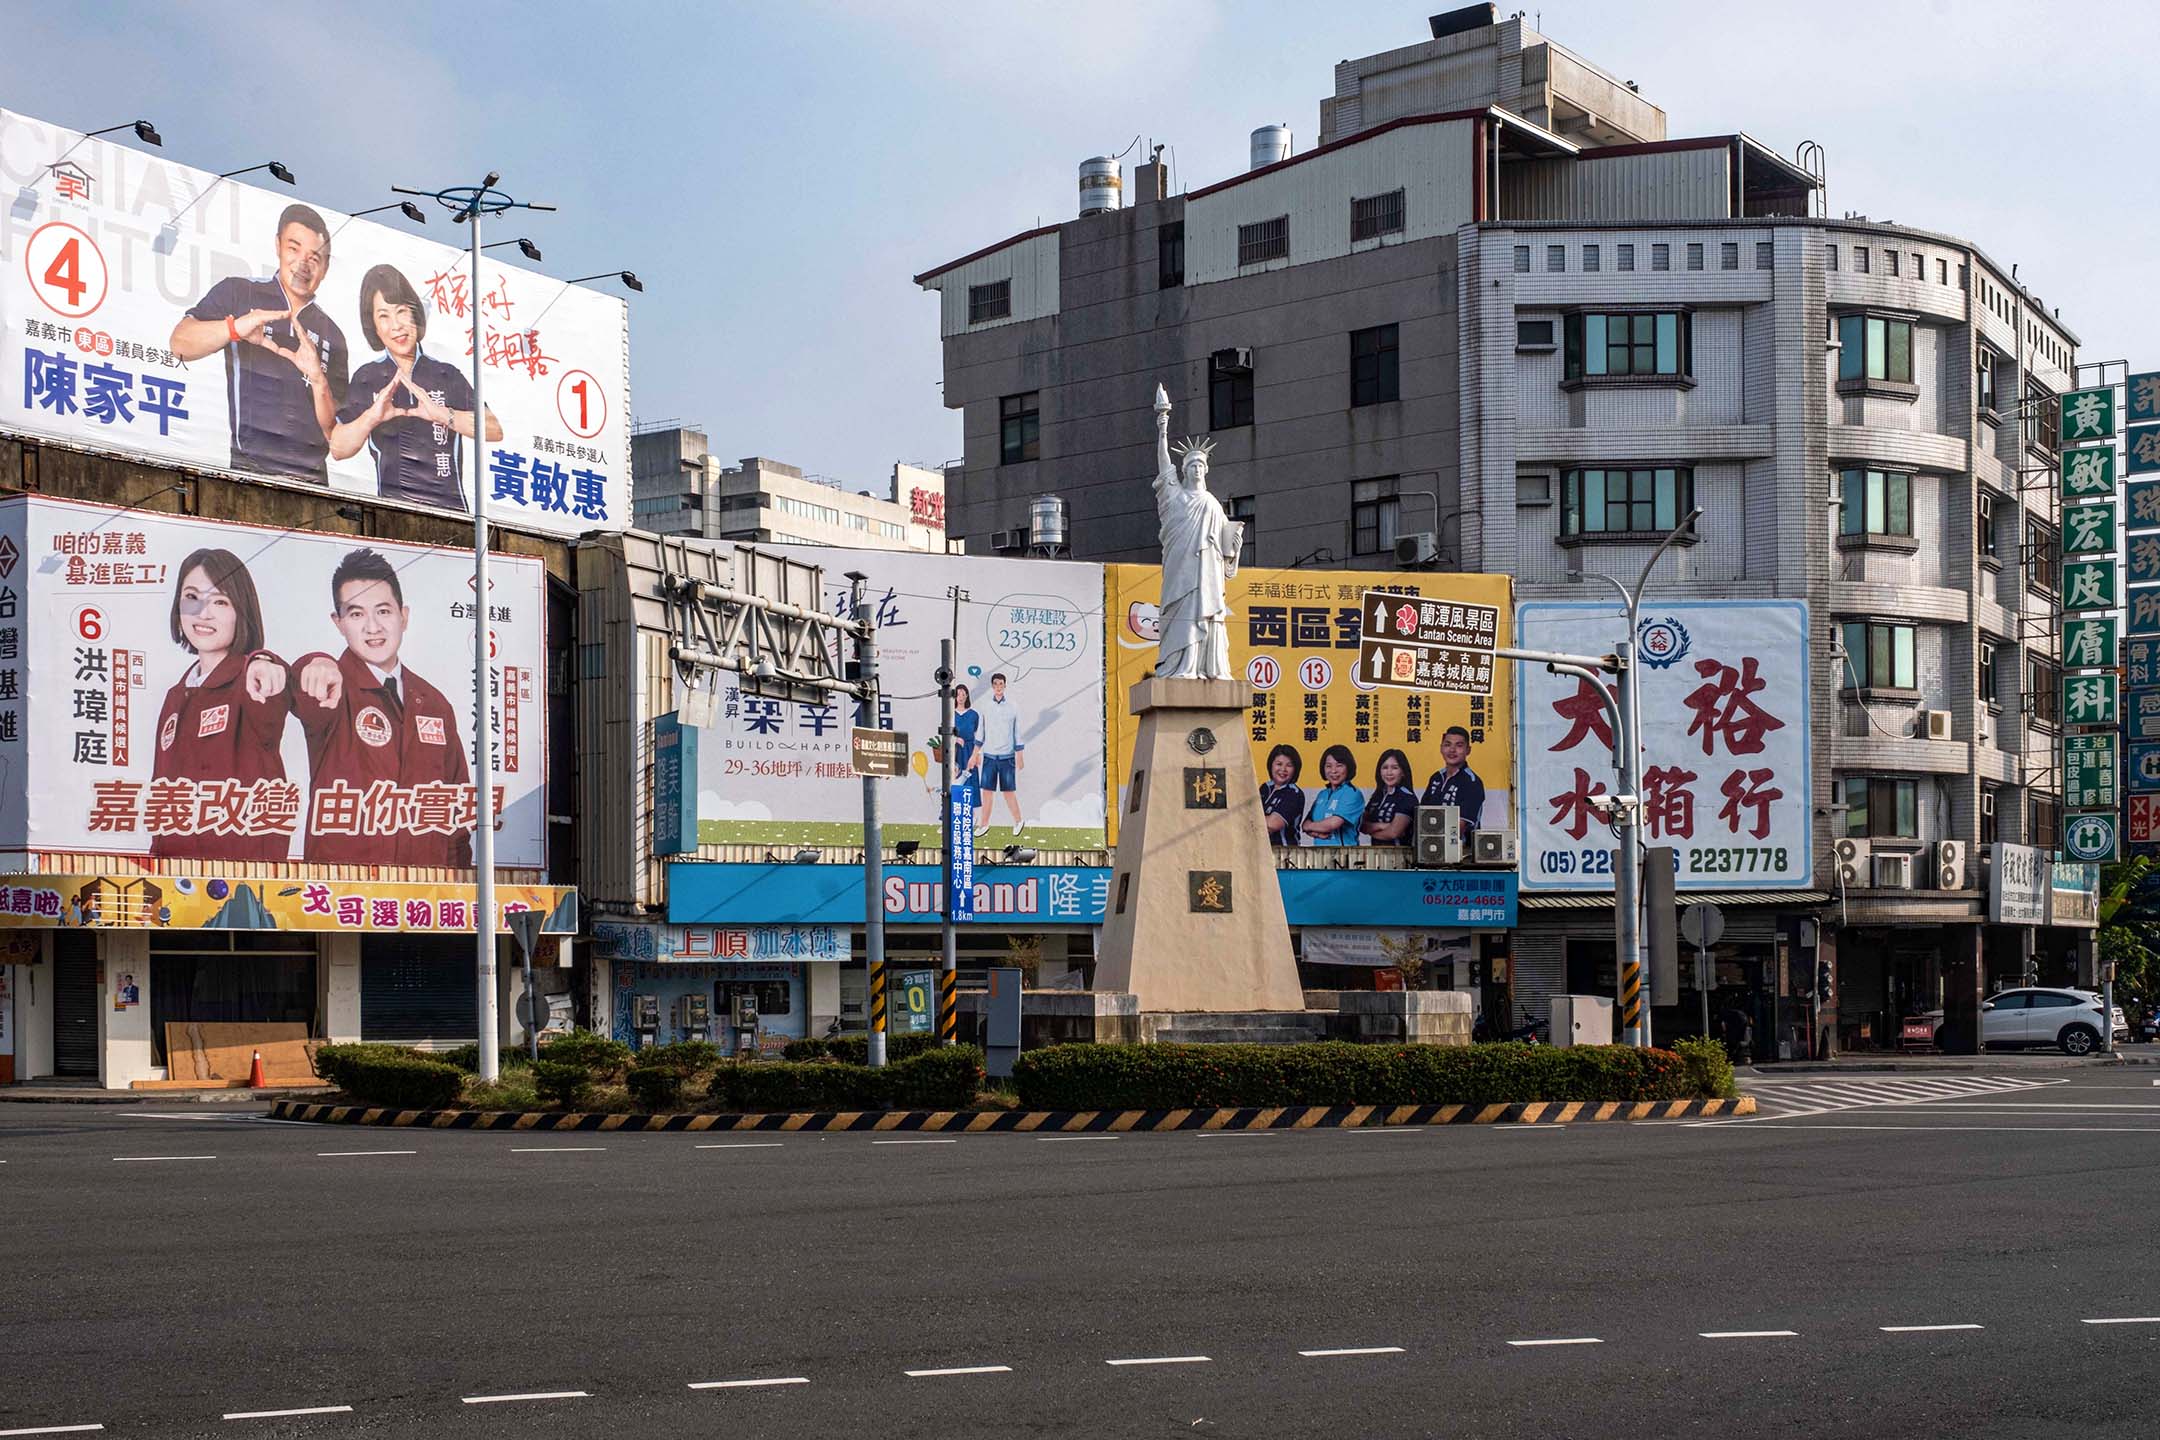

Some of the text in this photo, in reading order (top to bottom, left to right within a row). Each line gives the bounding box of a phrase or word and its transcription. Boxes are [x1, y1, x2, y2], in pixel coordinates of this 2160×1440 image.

[45, 238, 86, 307] 4
[25, 318, 189, 371] 嘉義市東區議員參選人
[24, 347, 189, 436] 陳家平
[571, 379, 588, 430] 1
[532, 435, 608, 465] 嘉義市長參選人
[489, 449, 609, 522] 黃敏惠
[53, 532, 147, 555] 咱的嘉義
[2064, 393, 2111, 721] 黃敏宏皮膚科
[66, 555, 167, 586] 基進監工!
[1249, 583, 1330, 600] 幸福進行式
[79, 608, 101, 640] 6
[1010, 608, 1067, 627] 漢昇建設
[1420, 603, 1494, 632] 蘭潭風景區
[999, 630, 1076, 651] 2356.123
[1418, 627, 1492, 646] Lantan Scenic Area
[1650, 629, 1668, 651] 大裕
[0, 585, 19, 742] 台灣基進
[132, 655, 144, 686] 西區
[1416, 661, 1490, 684] 嘉義城隍廟
[1417, 648, 1491, 666] 國定古蹟
[2131, 643, 2149, 684] 骨科
[521, 671, 531, 699] 東區
[1254, 664, 1273, 684] 20
[1306, 666, 1323, 684] 13
[1415, 678, 1432, 689] Chiayi
[1433, 680, 1445, 690] City
[1471, 683, 1489, 692] Temple
[73, 646, 108, 765] 洪瑋庭
[114, 653, 127, 763] 嘉義市議員候選人
[725, 687, 740, 719] 漢昇
[1252, 693, 1267, 741] 鄭光宏
[1304, 694, 1318, 742] 張秀華
[1355, 694, 1370, 743] 黃敏惠
[1407, 695, 1421, 743] 林雪峰
[1548, 657, 1785, 756] 大裕
[2138, 694, 2160, 736] 感冒
[725, 740, 774, 750] BUILD
[2073, 737, 2107, 750] 主治
[724, 759, 803, 778] 29-36地坪
[2067, 752, 2080, 806] 包皮過長
[2099, 751, 2112, 805] 青春痘
[1192, 773, 1222, 804] 博
[1548, 766, 1784, 841] 水箱行
[88, 778, 505, 836] 嘉義改變 由你實現
[2131, 800, 2149, 837] X光
[953, 801, 962, 889] 聯合服務中心
[963, 788, 972, 889] 行政院雲嘉南區
[1540, 851, 1577, 874] (05)
[1690, 848, 1788, 873] 2237778
[303, 885, 528, 929] 戈哥選物販
[885, 876, 1038, 913] Suand
[1198, 877, 1225, 909] 愛
[951, 910, 973, 921] 1.8km
[674, 927, 840, 960] 上順加水站
[908, 987, 925, 1013] 0
